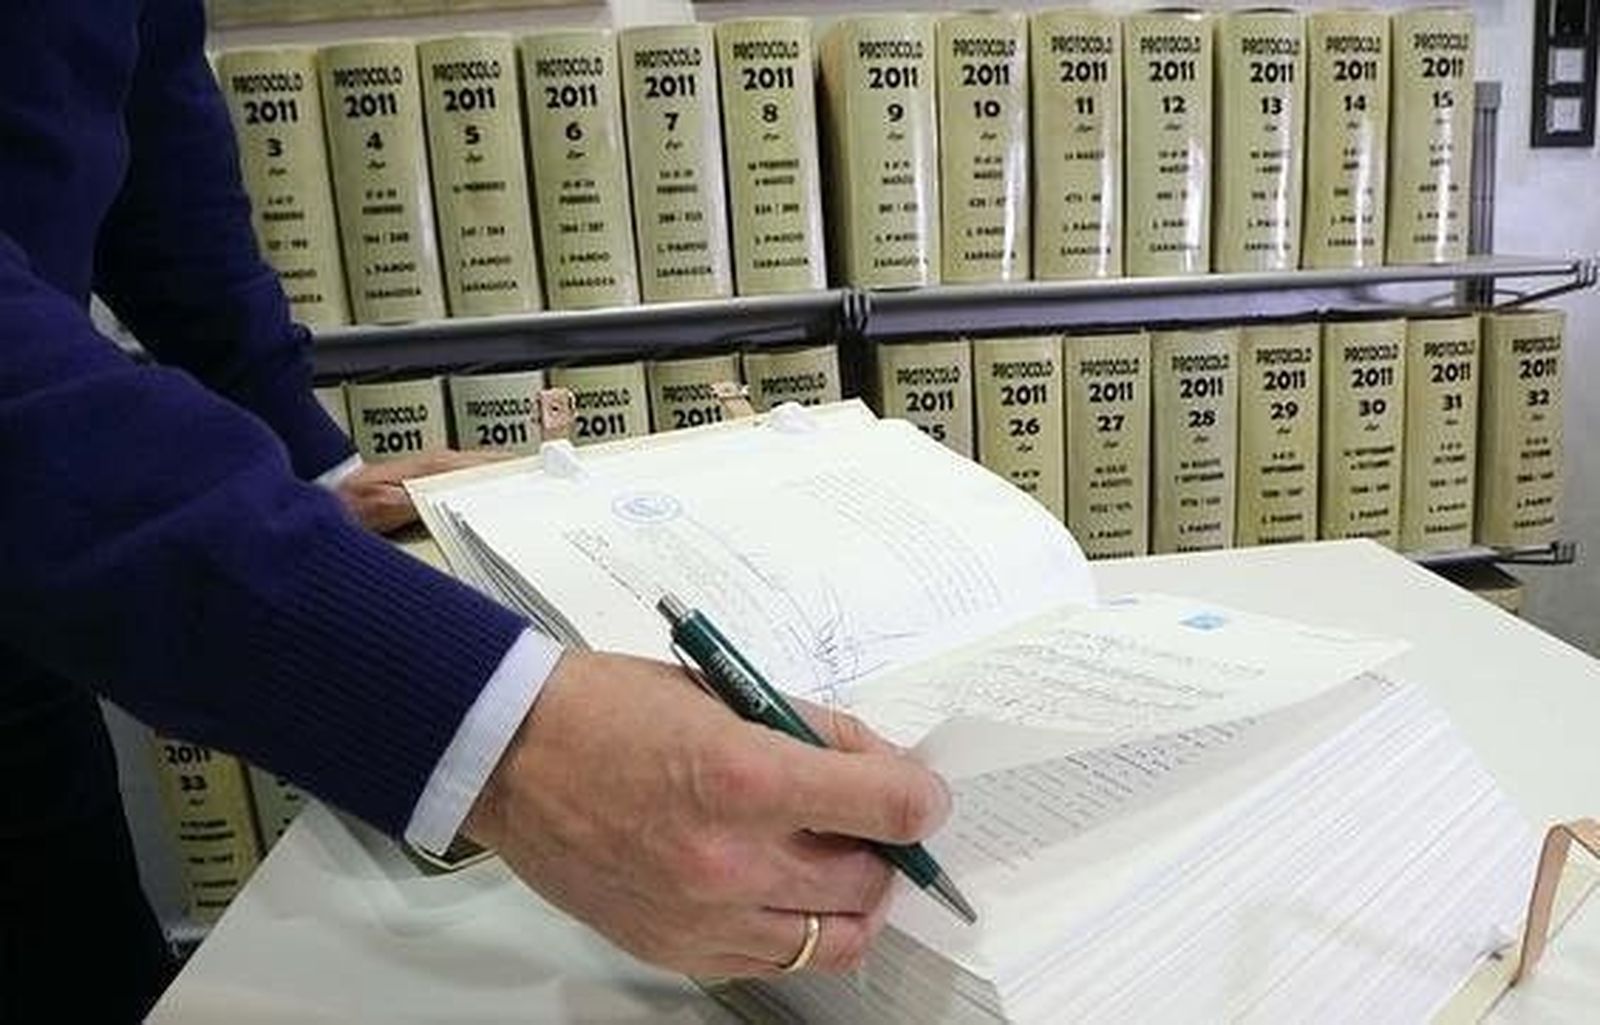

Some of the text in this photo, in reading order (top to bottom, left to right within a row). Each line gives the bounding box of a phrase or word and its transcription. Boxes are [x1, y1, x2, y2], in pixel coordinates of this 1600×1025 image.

[868, 67, 918, 88] 2011
[963, 64, 1010, 86] 2011
[1060, 62, 1107, 82] 2011
[1149, 61, 1195, 82] 2011
[1250, 62, 1293, 83] 2011
[1334, 61, 1377, 81] 2011
[1422, 58, 1464, 78] 2011
[645, 75, 695, 99] 2011
[743, 67, 794, 90] 2011
[344, 93, 397, 118] 2011
[443, 87, 496, 112] 2011
[545, 85, 597, 108] 2011
[1076, 97, 1094, 115] 11
[1162, 97, 1185, 114] 12
[1261, 98, 1283, 115] 13
[1344, 96, 1366, 112] 14
[1433, 91, 1453, 109] 15
[245, 100, 298, 124] 2011
[762, 103, 778, 123] 8
[887, 104, 903, 122] 9
[974, 101, 1000, 118] 10
[565, 122, 582, 140] 6
[664, 113, 678, 131] 7
[366, 132, 383, 150] 4
[465, 125, 480, 145] 5
[266, 138, 282, 157] 3
[1352, 367, 1394, 387] 2011
[1431, 363, 1471, 383] 2011
[1519, 357, 1557, 379] 2011
[1180, 378, 1224, 399] 2011
[1264, 370, 1306, 391] 2011
[906, 389, 954, 412] 2011
[1001, 384, 1047, 406] 2011
[1088, 382, 1134, 403] 2011
[1442, 394, 1463, 411] 31
[1527, 389, 1550, 406] 32
[673, 405, 723, 429] 2011
[1270, 402, 1298, 420] 29
[1359, 400, 1386, 416] 30
[576, 413, 626, 437] 2011
[1010, 419, 1040, 436] 26
[1098, 416, 1124, 432] 27
[1188, 410, 1216, 428] 28
[373, 430, 422, 453] 2011
[478, 425, 527, 446] 2011
[164, 745, 211, 766] 2011
